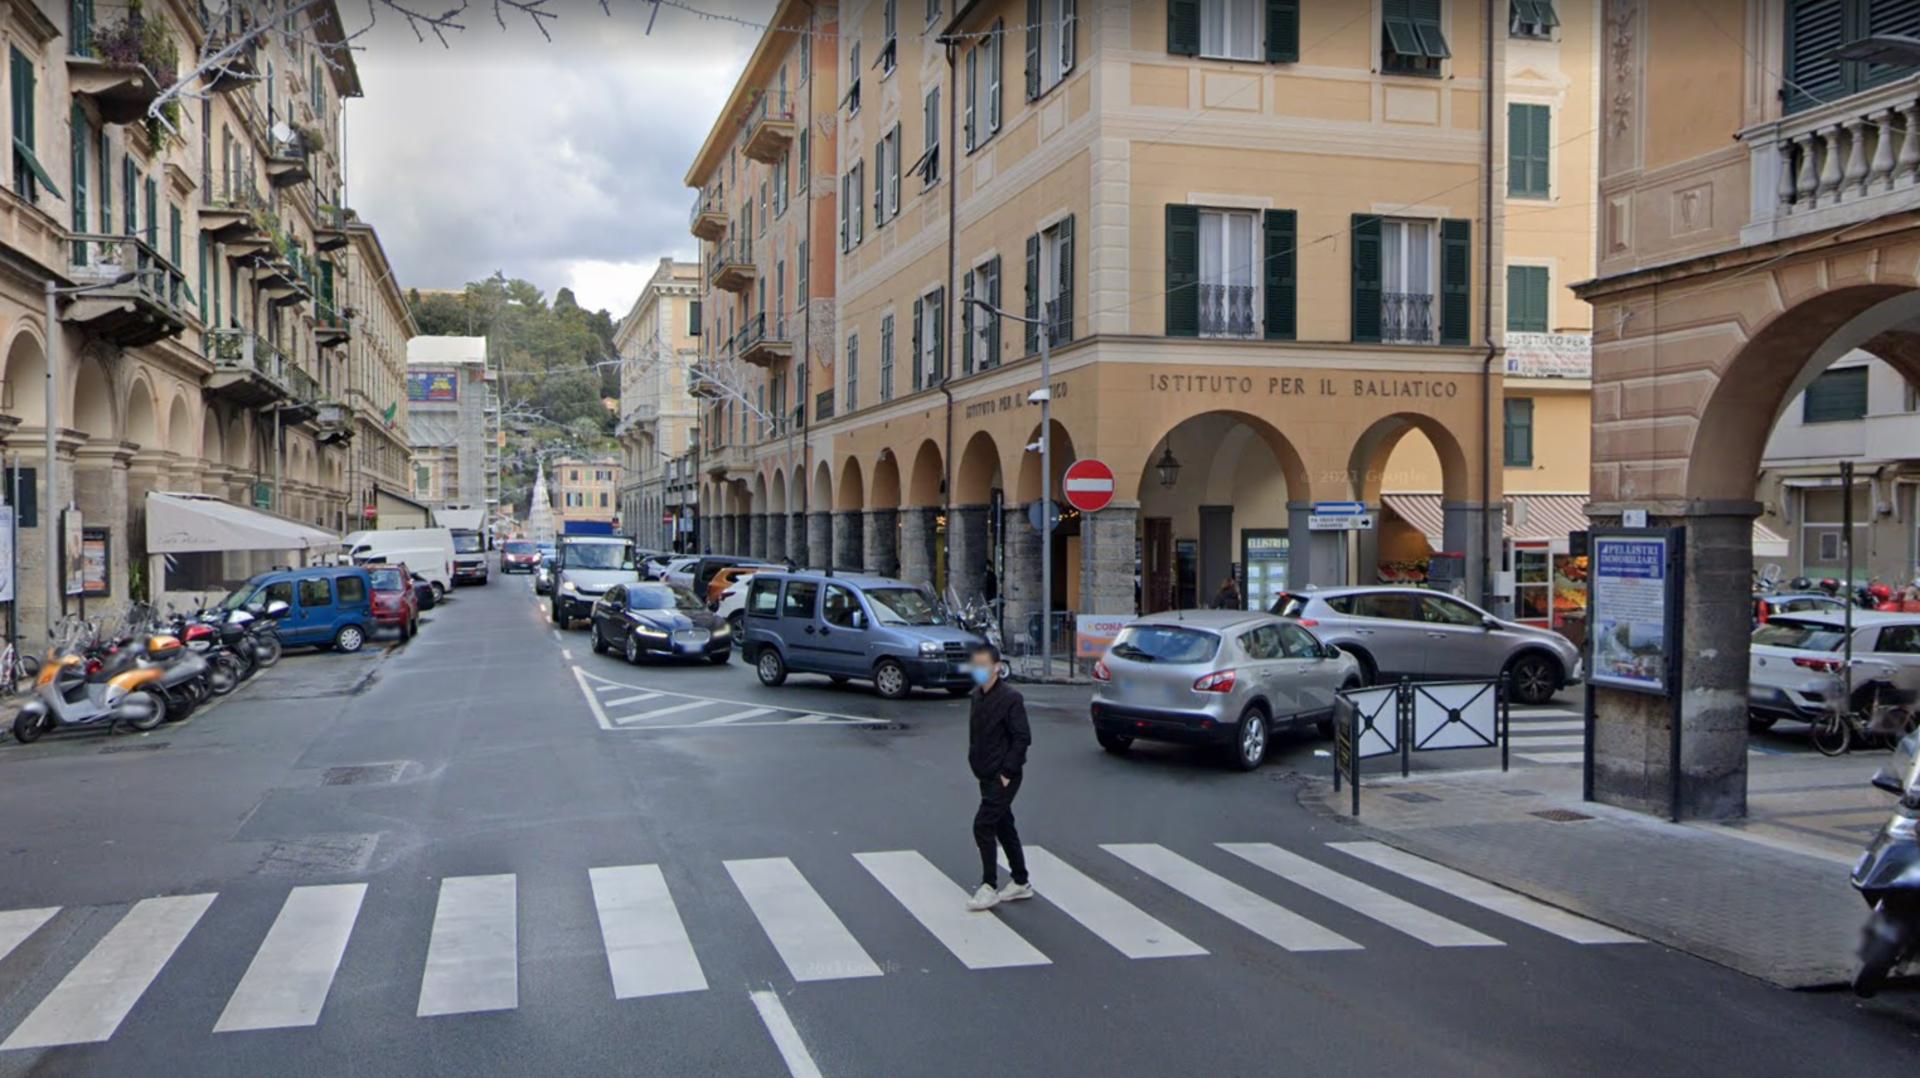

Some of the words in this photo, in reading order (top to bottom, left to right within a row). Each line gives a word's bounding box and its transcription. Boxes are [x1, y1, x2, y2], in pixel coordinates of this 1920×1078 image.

[1151, 374, 1251, 393] ISTITUTO
[1269, 377, 1305, 394] PER
[1320, 379, 1336, 395] IL
[1354, 379, 1457, 397] BALIATICO
[966, 400, 995, 418] ISTITUTO
[999, 395, 1012, 411] PER
[1016, 393, 1022, 407] IL
